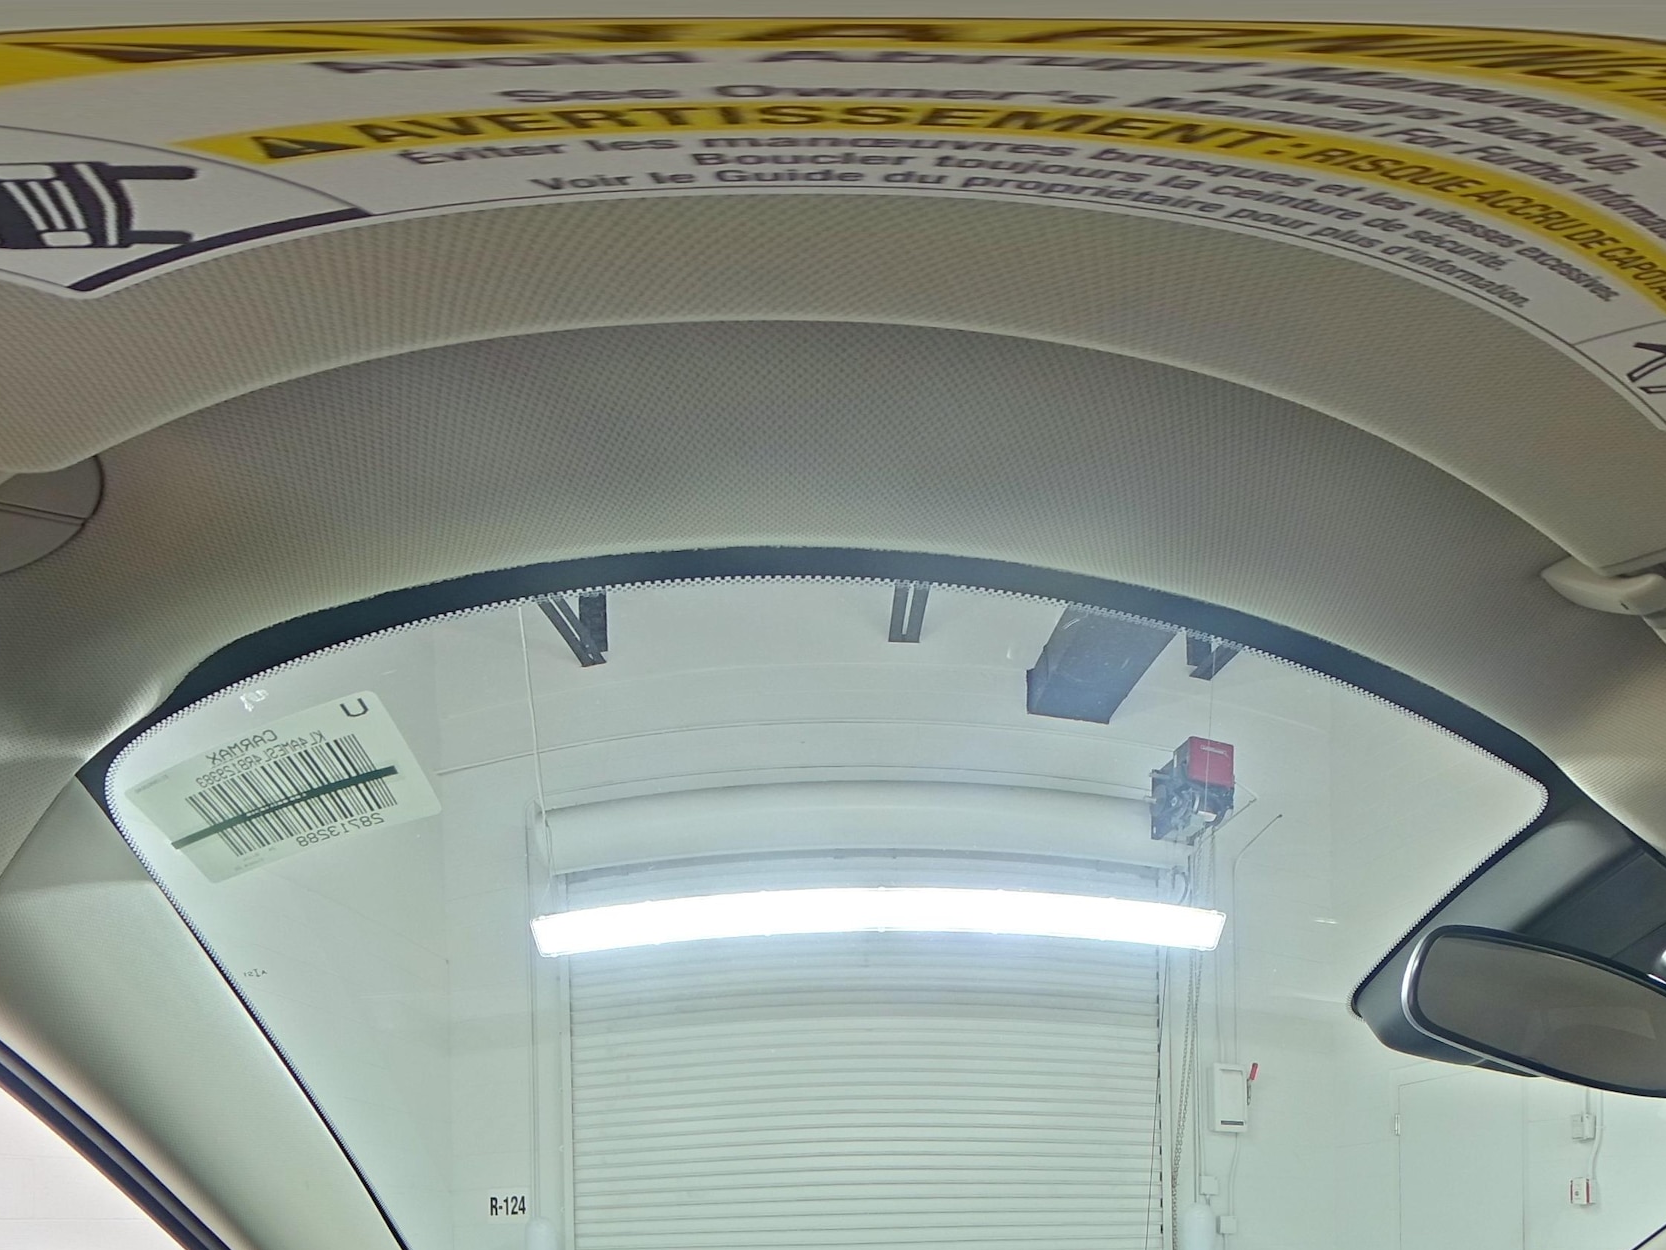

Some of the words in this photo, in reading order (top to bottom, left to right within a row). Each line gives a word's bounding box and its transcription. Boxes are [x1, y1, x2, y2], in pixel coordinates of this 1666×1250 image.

[528, 174, 632, 190] Voir
[646, 171, 696, 184] le
[713, 168, 865, 182] Guide
[881, 170, 948, 184] du
[958, 175, 1226, 213] propriétaire
[1222, 207, 1317, 229] pour
[1305, 226, 1385, 248] plus
[582, 138, 681, 152] les
[1086, 147, 1316, 187] brusques
[1312, 183, 1365, 197] et
[1355, 191, 1416, 211] les
[1412, 207, 1525, 248] vitesses
[689, 151, 918, 166] Boucler
[933, 154, 1151, 183] toujours
[1155, 174, 1205, 190] la
[1207, 184, 1365, 220] ceinture
[1360, 217, 1409, 232] de
[1293, 147, 1486, 193] RISQUE
[1457, 188, 1589, 231] ACCRU
[1561, 228, 1621, 249] DE
[490, 1195, 527, 1216] R-124
